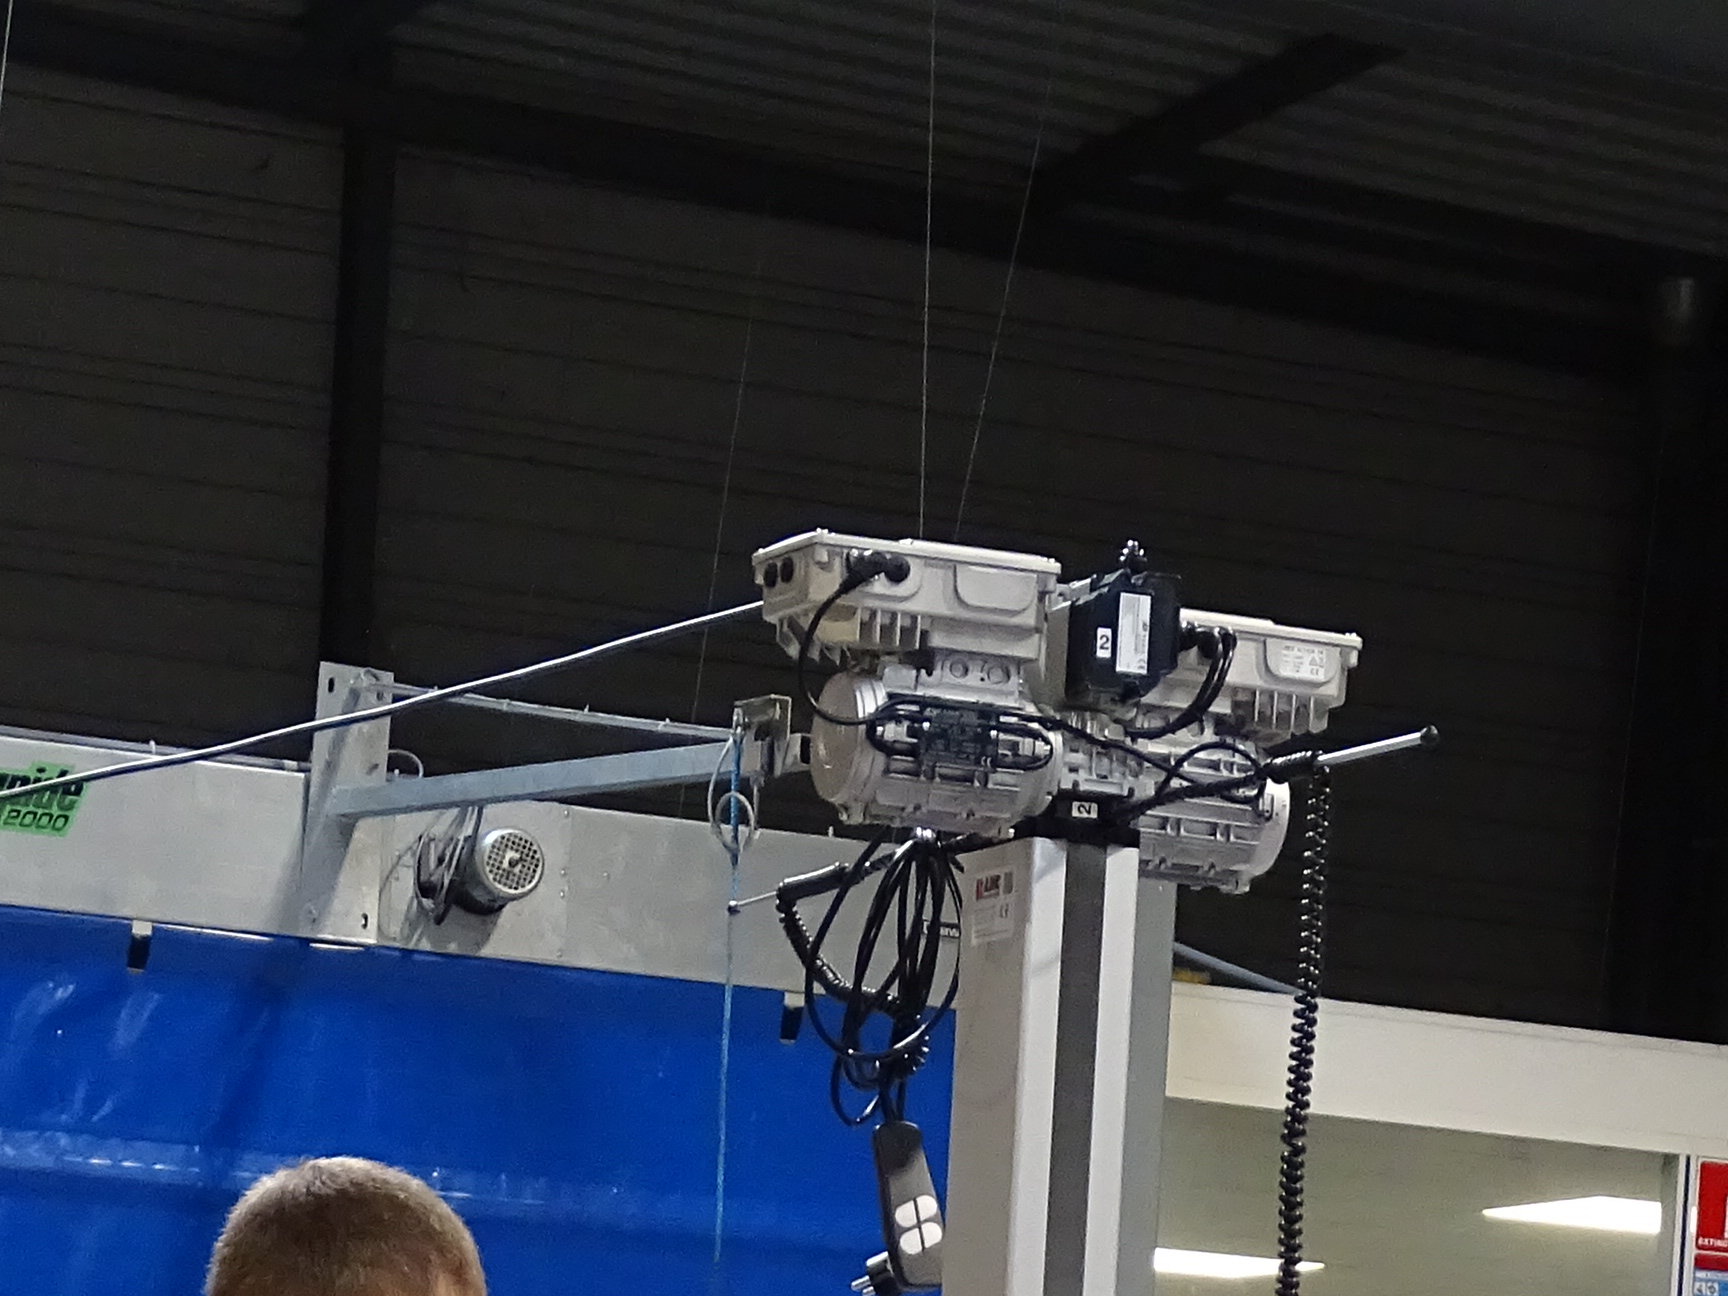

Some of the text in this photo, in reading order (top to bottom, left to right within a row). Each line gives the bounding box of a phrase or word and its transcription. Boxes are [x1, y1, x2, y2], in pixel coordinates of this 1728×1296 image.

[1098, 634, 1110, 650] 2
[1077, 802, 1092, 816] 2
[3, 808, 71, 832] 2000
